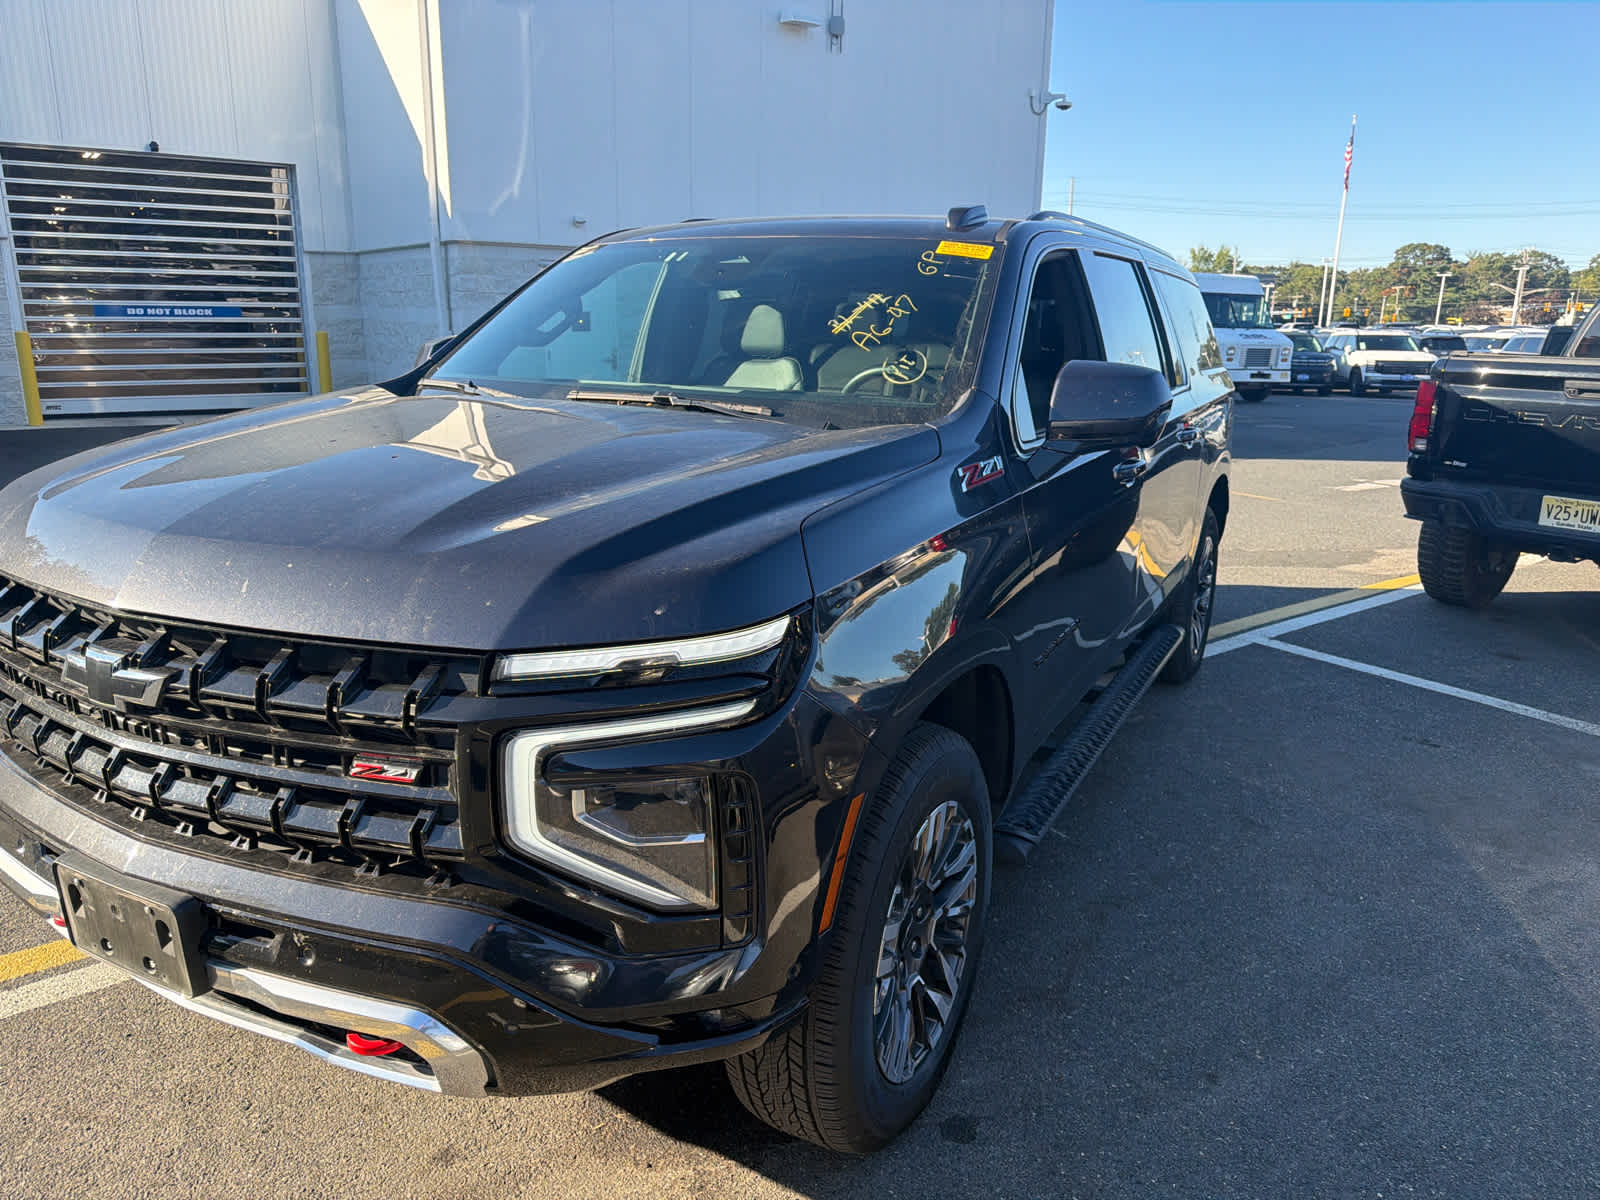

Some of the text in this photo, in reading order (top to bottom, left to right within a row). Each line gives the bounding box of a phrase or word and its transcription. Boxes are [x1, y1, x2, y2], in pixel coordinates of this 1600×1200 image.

[126, 307, 213, 316] DO NOT BLOCK
[957, 455, 1004, 493] Z71
[1546, 503, 1600, 526] V25 UW
[349, 762, 419, 784] Z71
